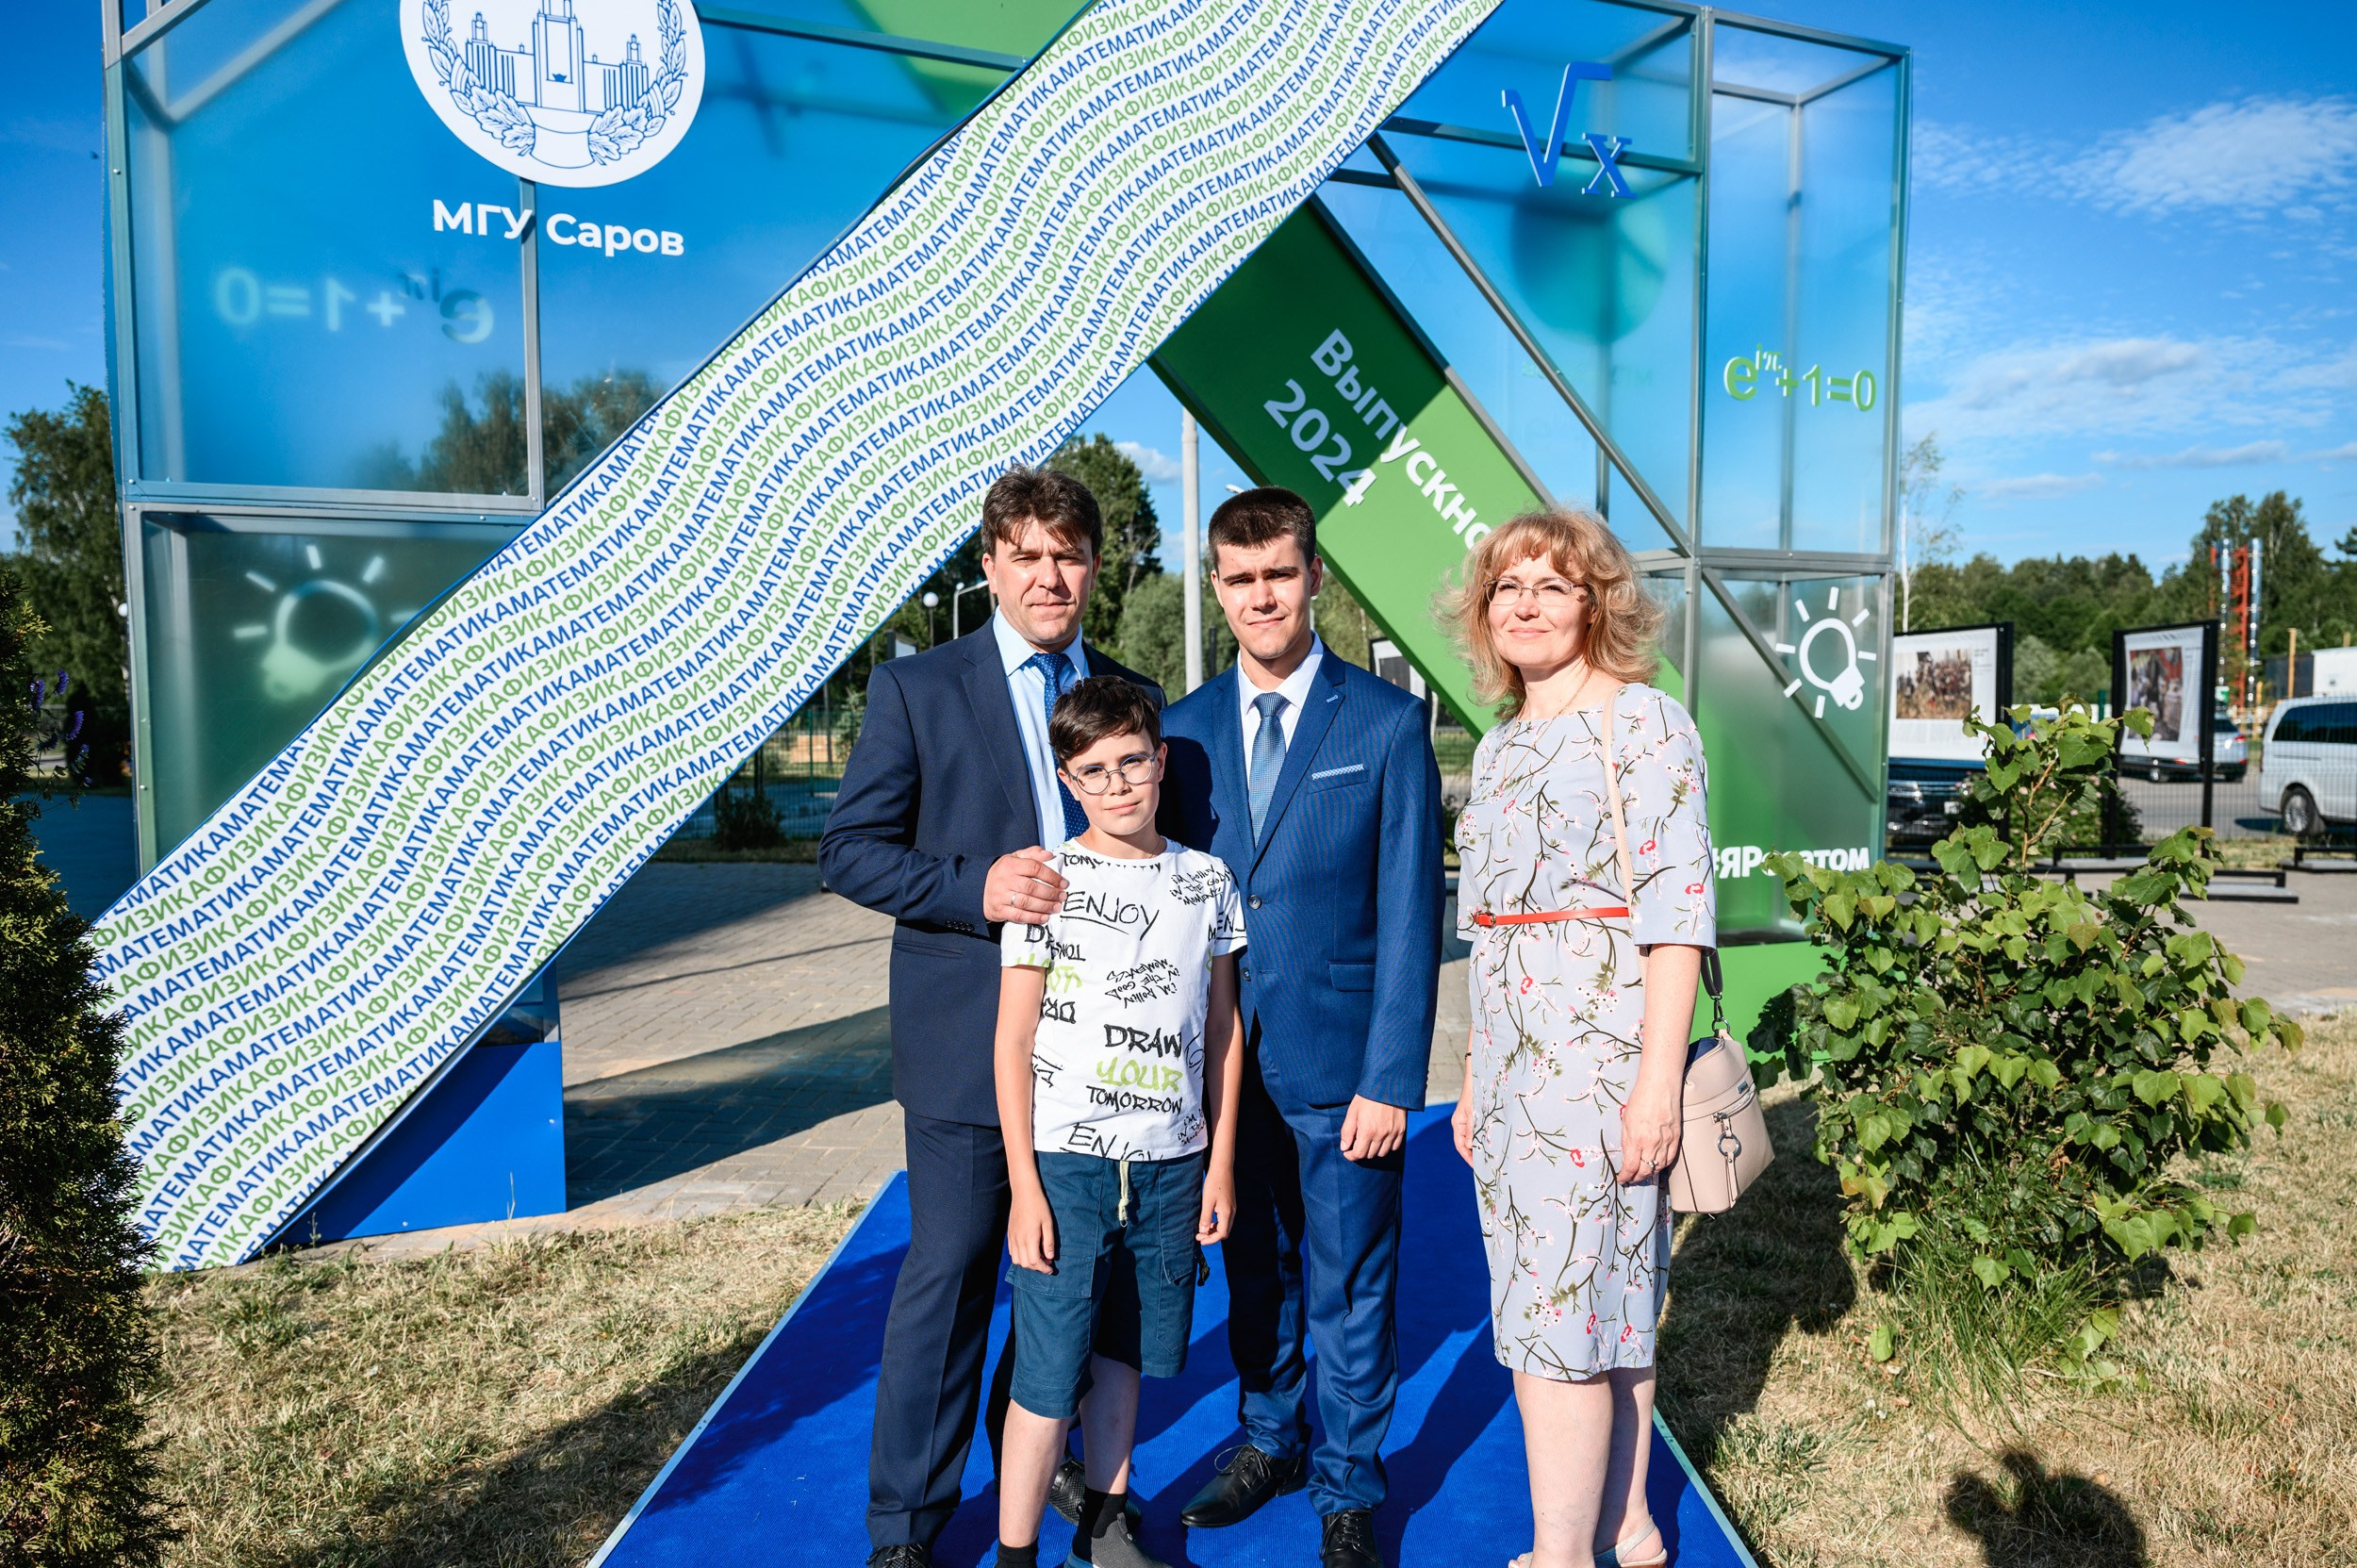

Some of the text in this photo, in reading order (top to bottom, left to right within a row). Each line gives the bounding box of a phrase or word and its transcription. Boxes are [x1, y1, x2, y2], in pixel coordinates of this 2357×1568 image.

[433, 199, 684, 257] МГУ Саров
[1263, 379, 1376, 507] 2024
[1063, 891, 1159, 941] ENJOY
[1104, 1024, 1181, 1058] DRAW
[1096, 1056, 1183, 1093] YOUR
[1086, 1085, 1182, 1114] TOMORROW
